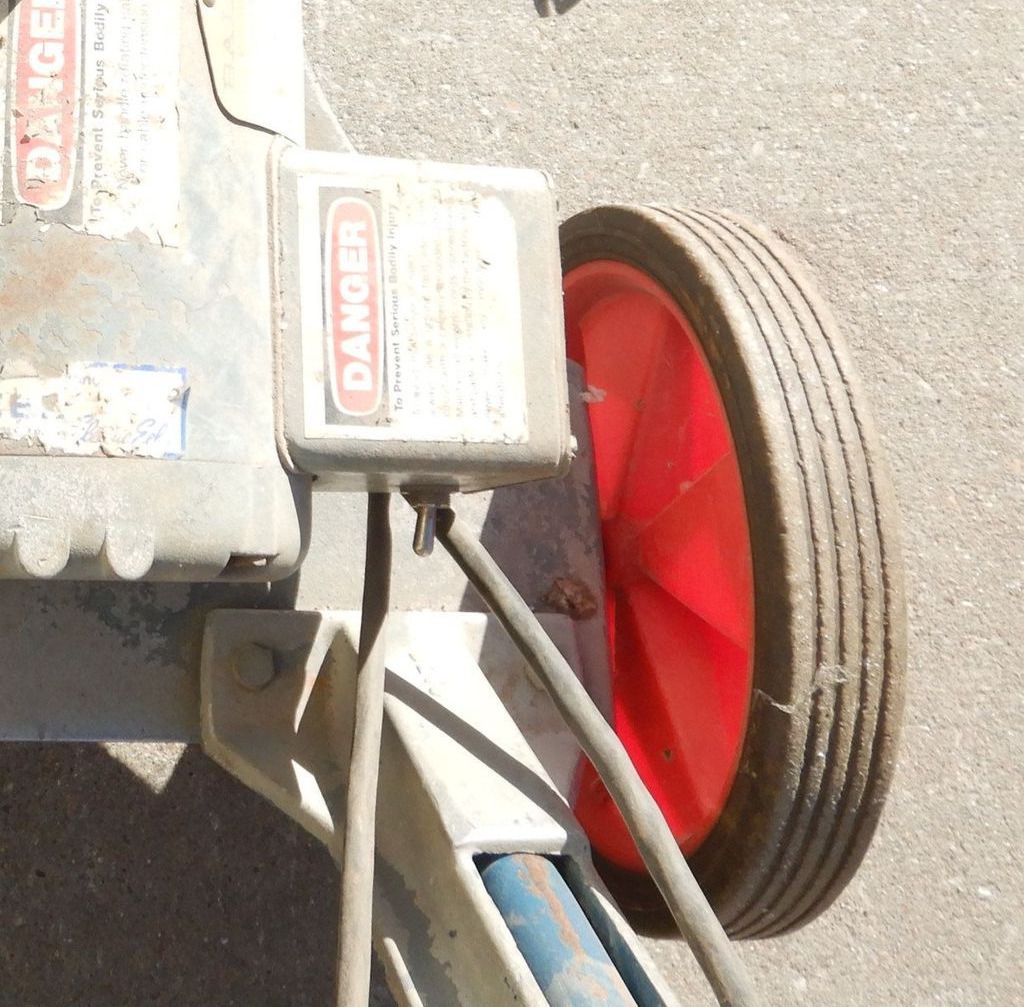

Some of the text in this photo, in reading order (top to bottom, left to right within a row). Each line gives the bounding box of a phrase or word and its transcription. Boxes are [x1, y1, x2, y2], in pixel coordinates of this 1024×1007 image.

[93, 2, 110, 51] Bodily
[91, 60, 106, 120] Serious
[90, 126, 104, 187] Prevent
[338, 220, 373, 391] DANGER
[386, 202, 404, 412] To Prevent Serious Bodily Injury
